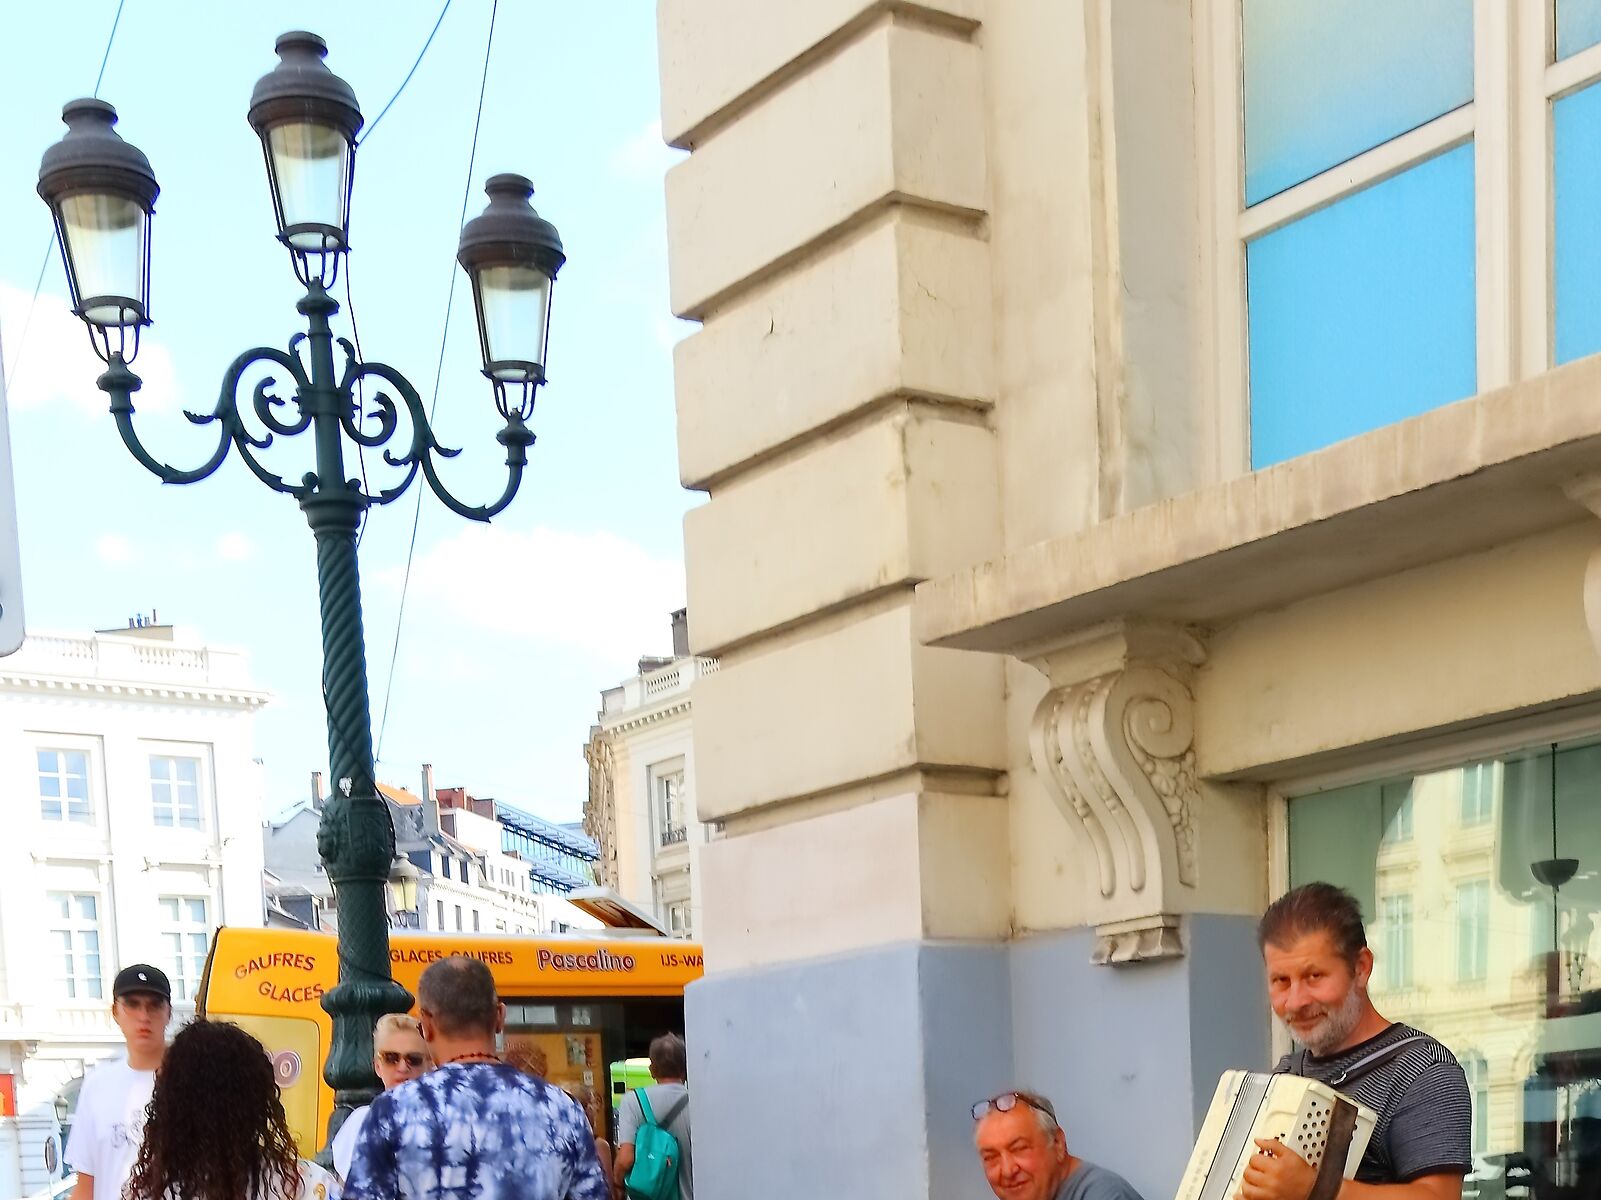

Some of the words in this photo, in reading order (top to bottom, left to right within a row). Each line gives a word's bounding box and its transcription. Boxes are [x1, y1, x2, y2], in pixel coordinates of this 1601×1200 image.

[234, 952, 316, 980] GAUFRES
[389, 949, 442, 963] GLACES
[536, 948, 636, 972] Pascalino
[258, 980, 325, 1003] GLACES
